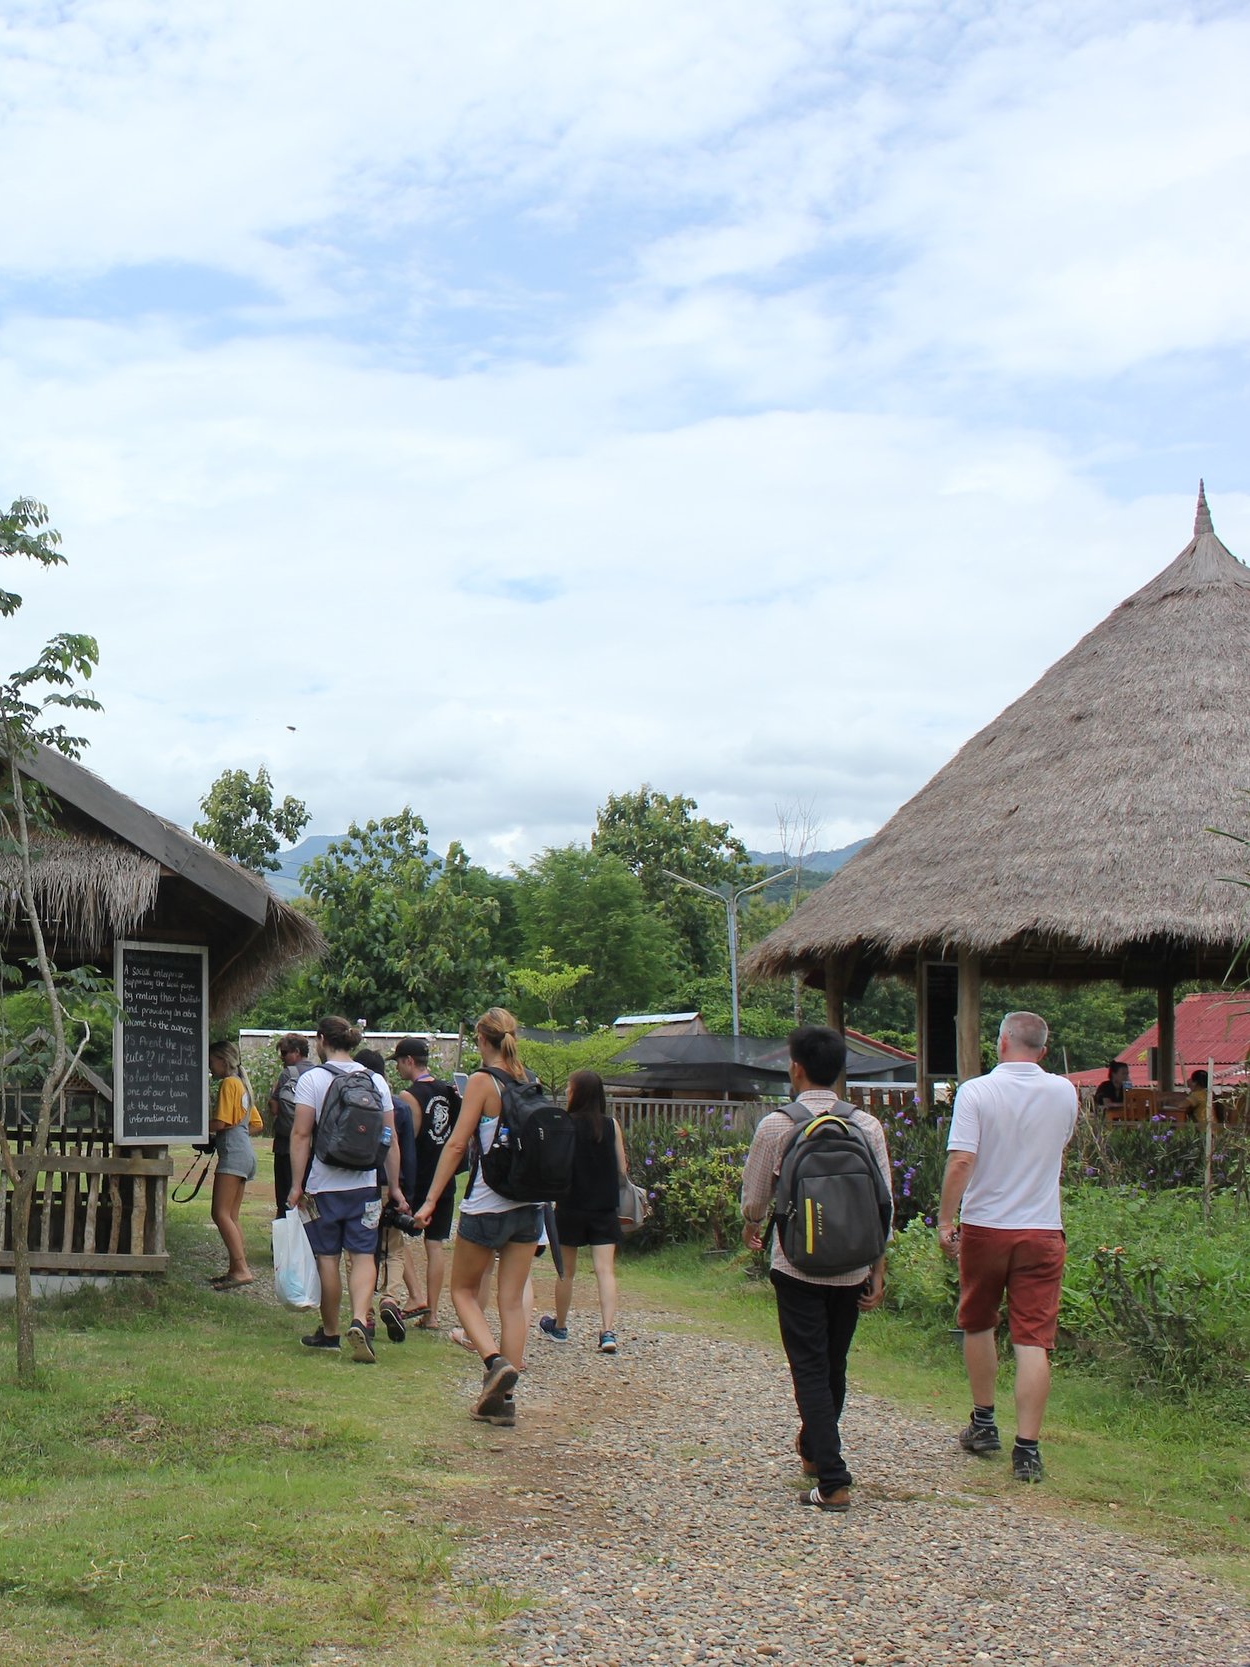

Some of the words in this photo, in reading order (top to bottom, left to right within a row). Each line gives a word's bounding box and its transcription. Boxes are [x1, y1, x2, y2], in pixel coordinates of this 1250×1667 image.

[124, 964, 129, 975] A
[155, 979, 164, 988] the
[124, 990, 133, 1002] by
[135, 991, 158, 1005] renting
[141, 1006, 172, 1021] providing
[149, 1018, 157, 1029] to
[158, 1020, 170, 1031] the
[127, 1088, 140, 1096] one
[143, 1085, 152, 1096] of
[152, 1089, 165, 1097] our
[138, 1100, 148, 1111] the
[152, 1100, 177, 1113] tourist
[129, 1113, 165, 1124] information
